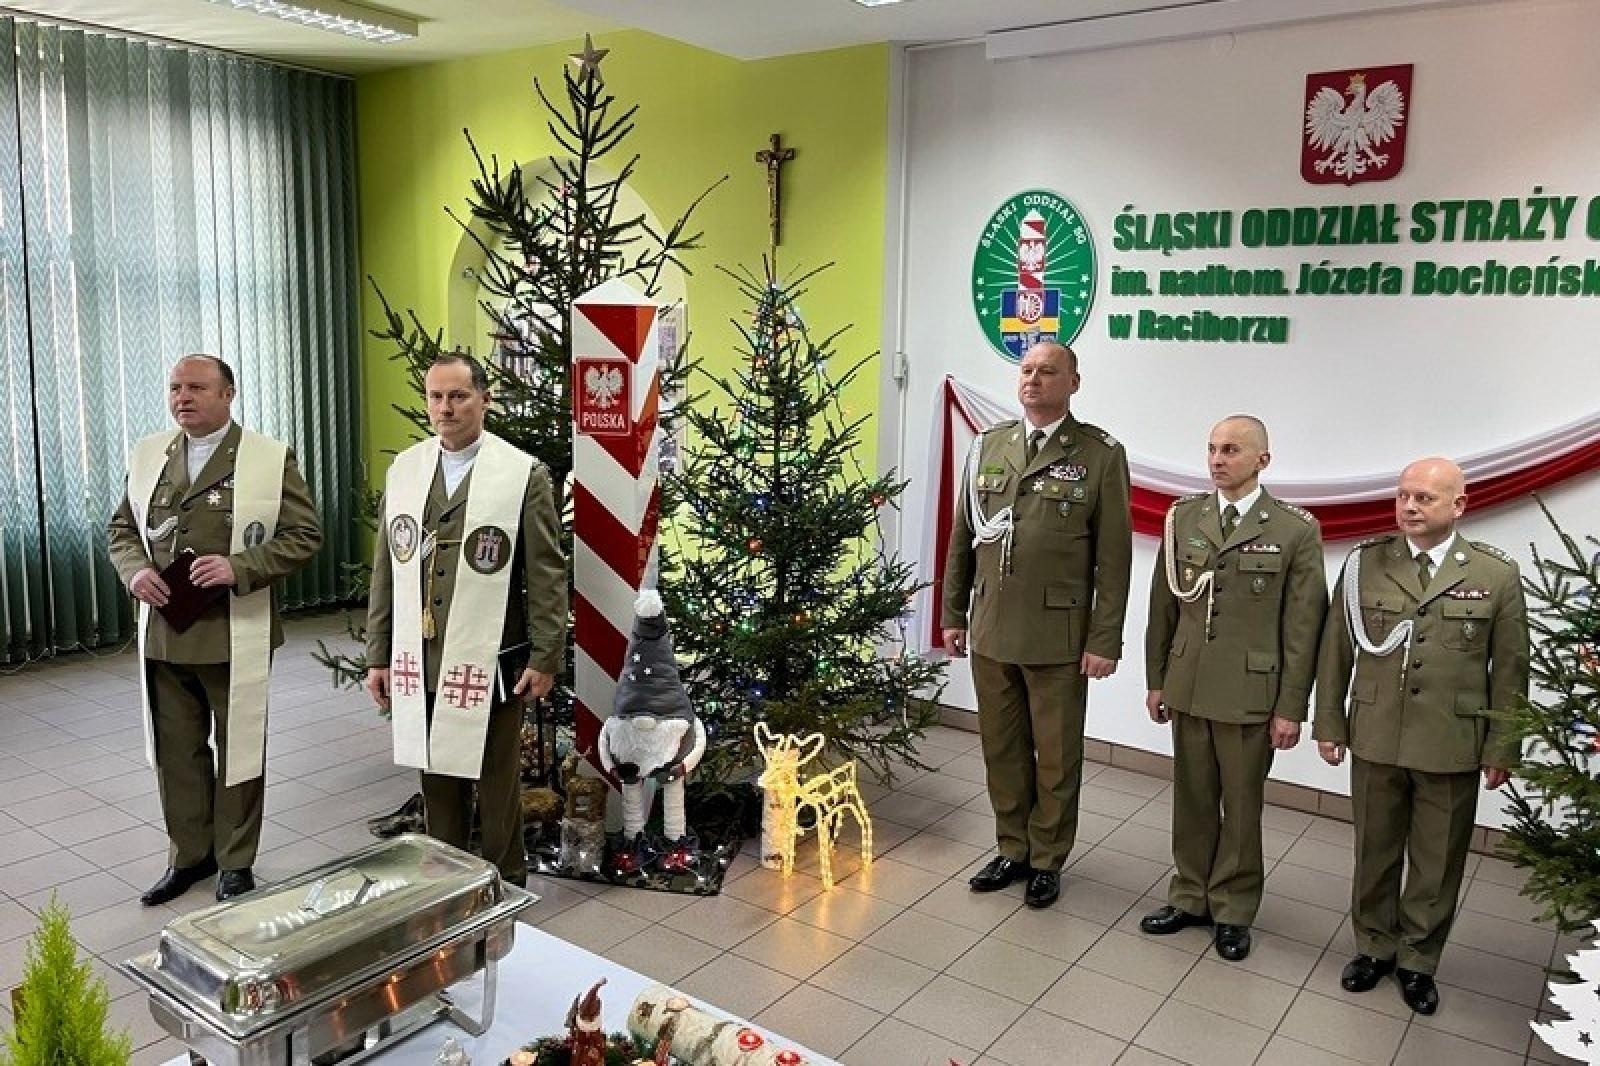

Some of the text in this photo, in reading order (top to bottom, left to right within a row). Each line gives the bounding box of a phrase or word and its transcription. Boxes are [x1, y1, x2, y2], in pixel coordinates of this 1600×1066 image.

[1113, 204, 1233, 256] ŚLĄSKI
[1241, 203, 1401, 248] ODDZIAŁ
[1410, 186, 1578, 242] STRAŻY
[1111, 255, 1600, 296] im. nadkom. Józefa Bocheńsk
[1108, 310, 1288, 343] w Raciborzu
[583, 412, 625, 428] POLSKA
